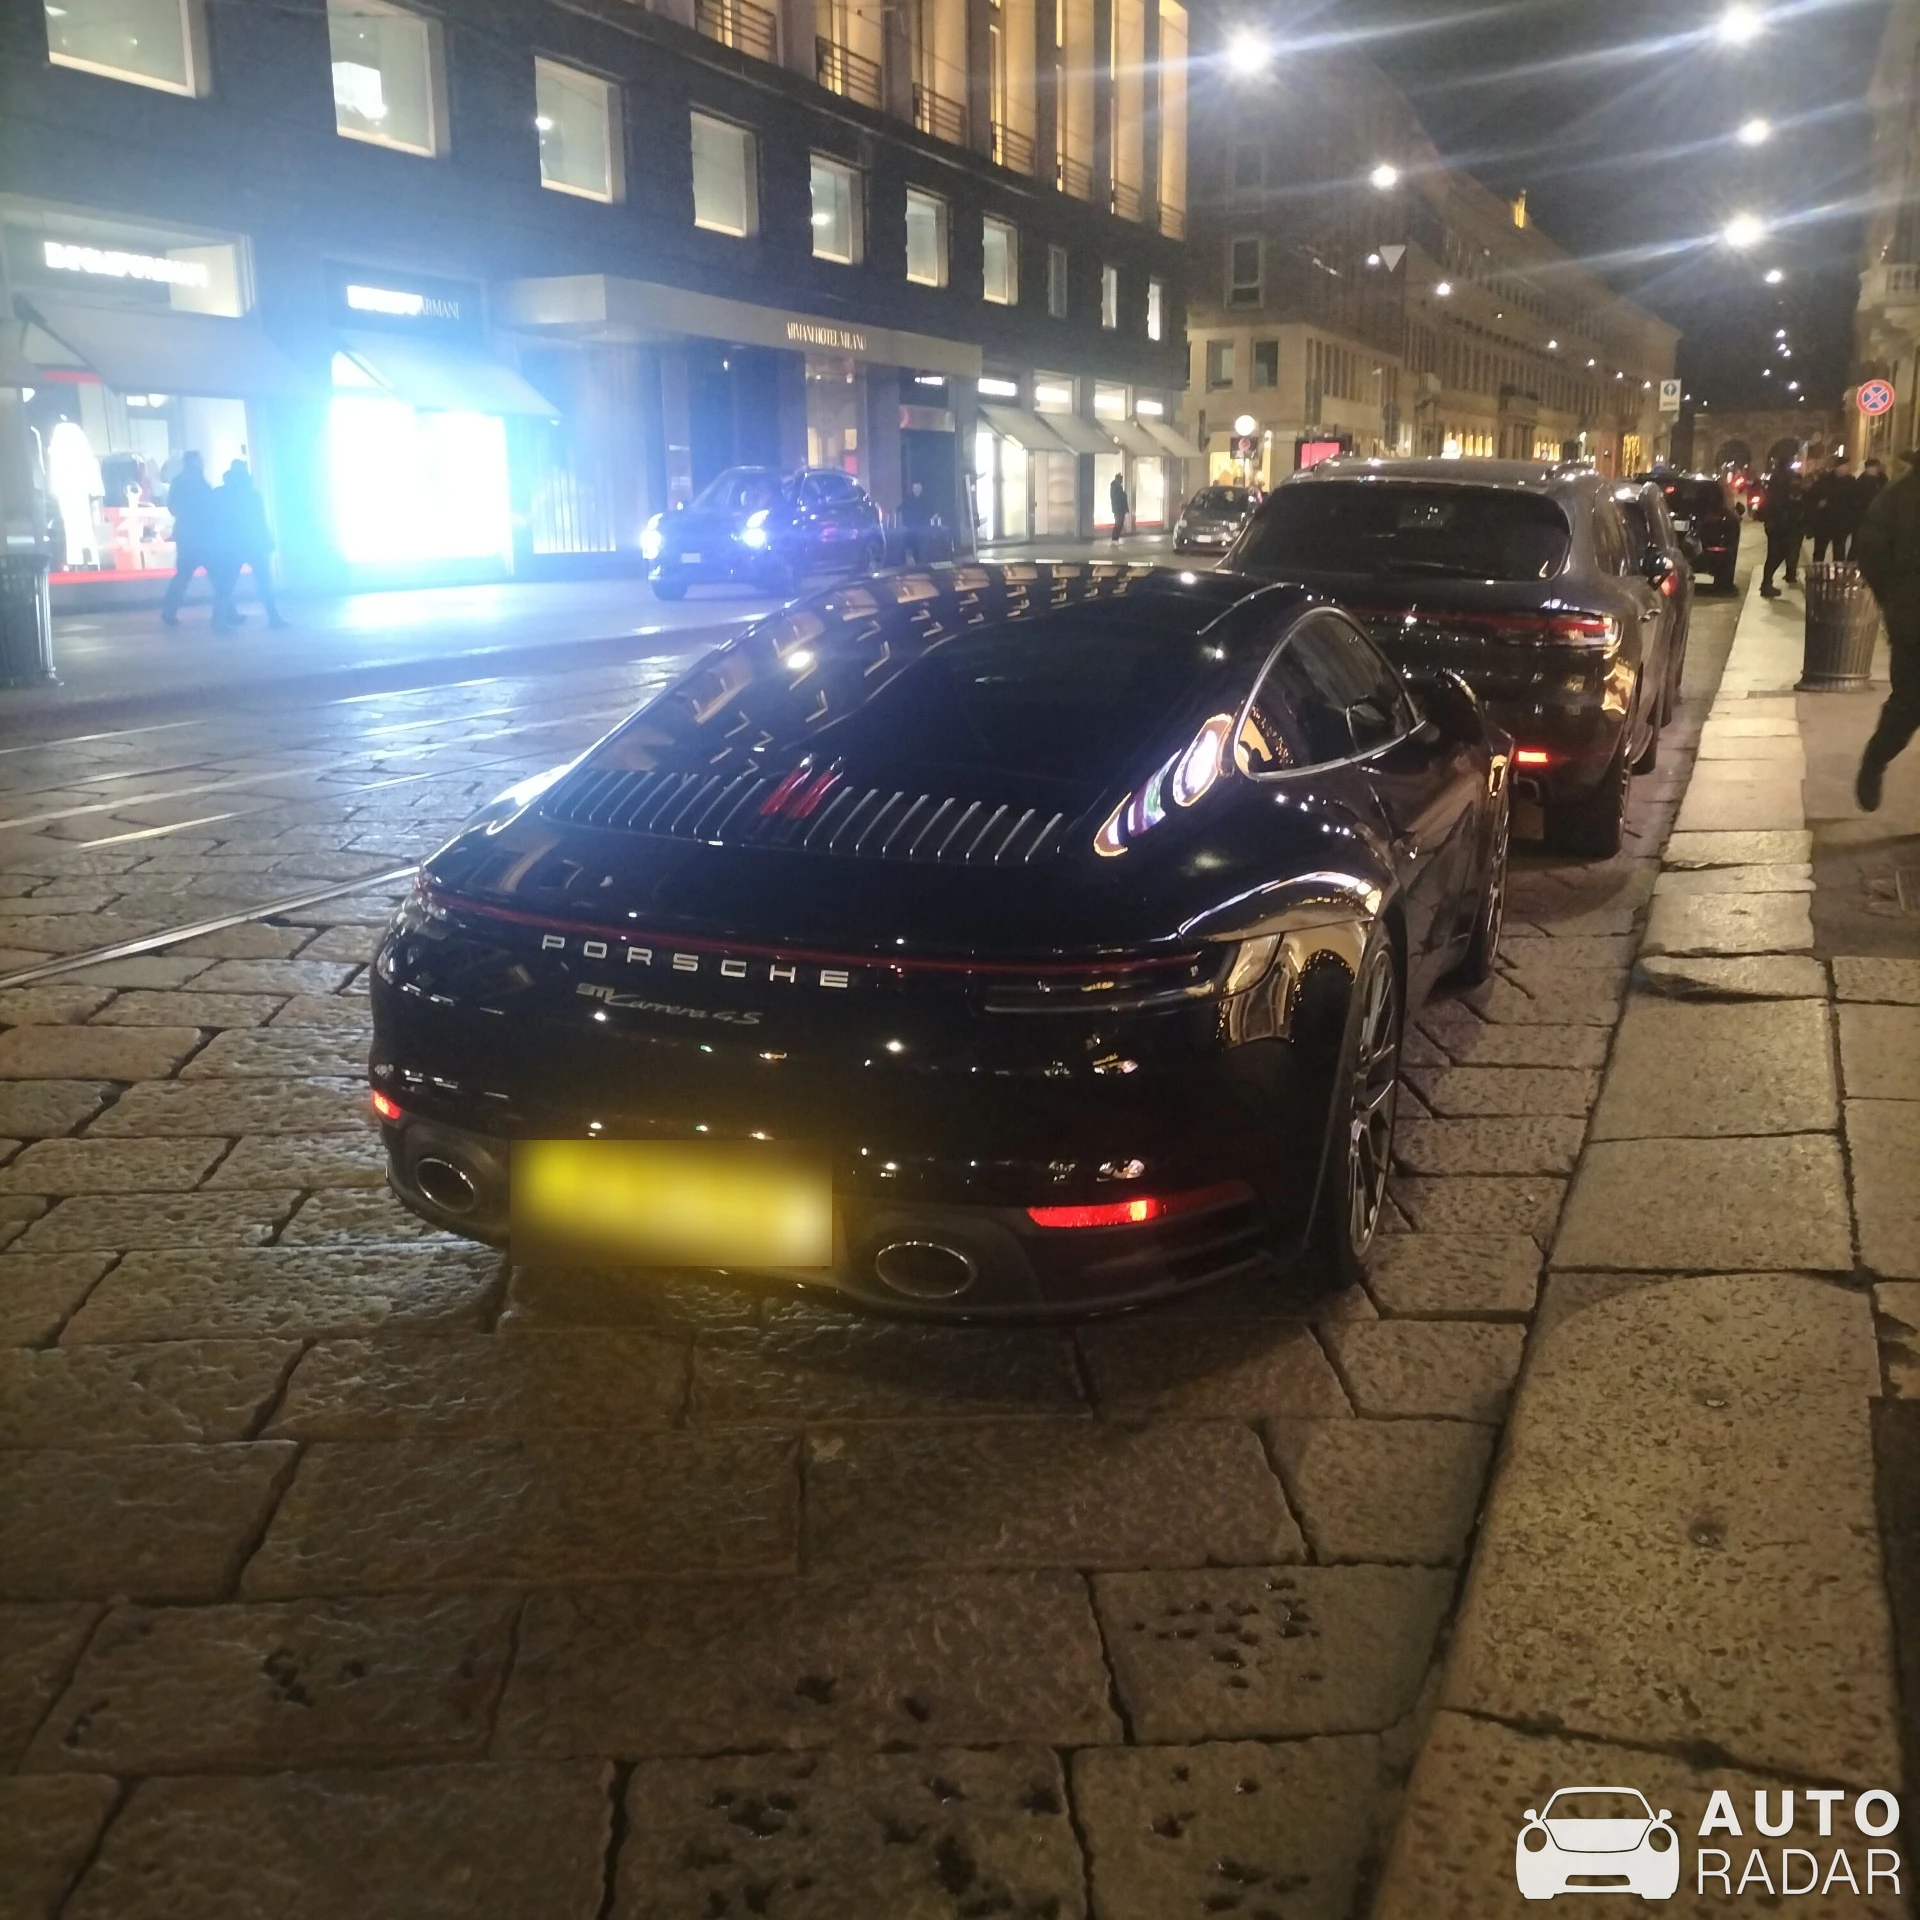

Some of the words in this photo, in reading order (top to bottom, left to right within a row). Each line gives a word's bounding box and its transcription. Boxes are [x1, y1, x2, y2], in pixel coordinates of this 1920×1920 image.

[815, 327, 839, 348] HOTEL
[542, 934, 849, 989] PORSCHE
[604, 994, 707, 1019] Carrera
